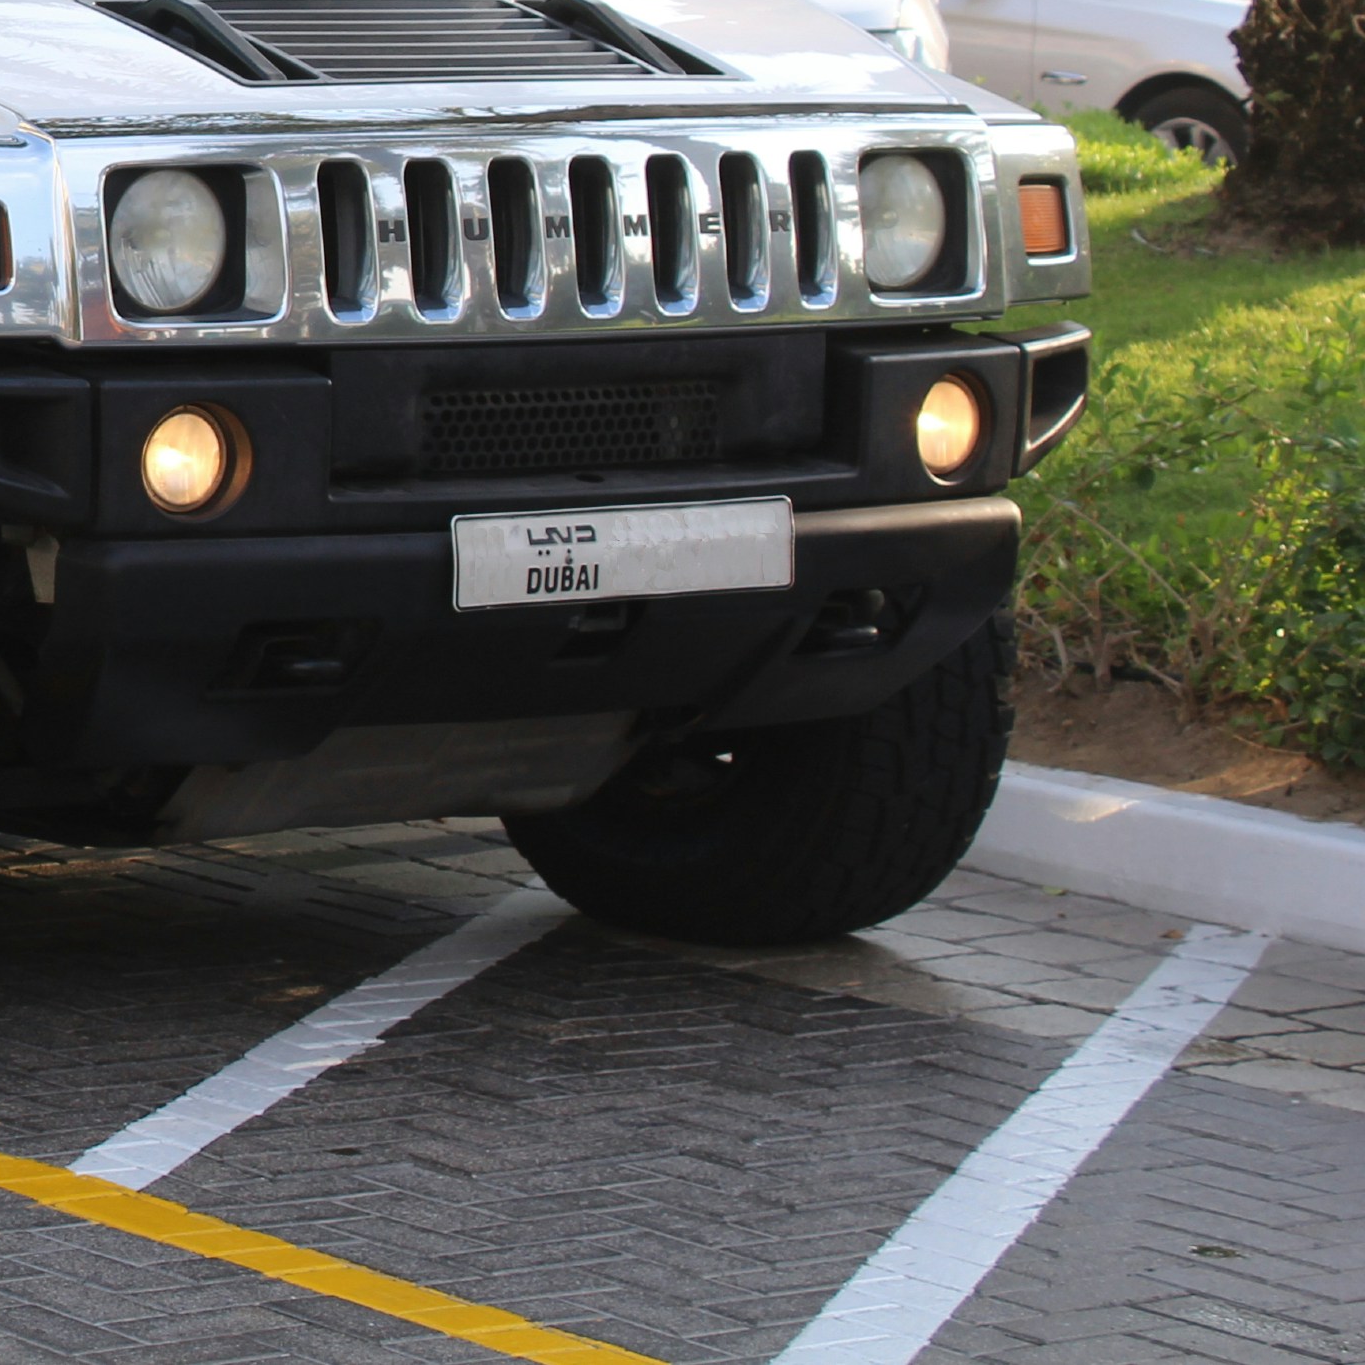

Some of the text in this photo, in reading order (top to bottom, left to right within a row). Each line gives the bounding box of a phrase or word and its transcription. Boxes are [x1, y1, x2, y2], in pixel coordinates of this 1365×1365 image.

[378, 209, 792, 243] HUMMER
[527, 524, 597, 556] دبي
[526, 563, 600, 595] DUBAI
